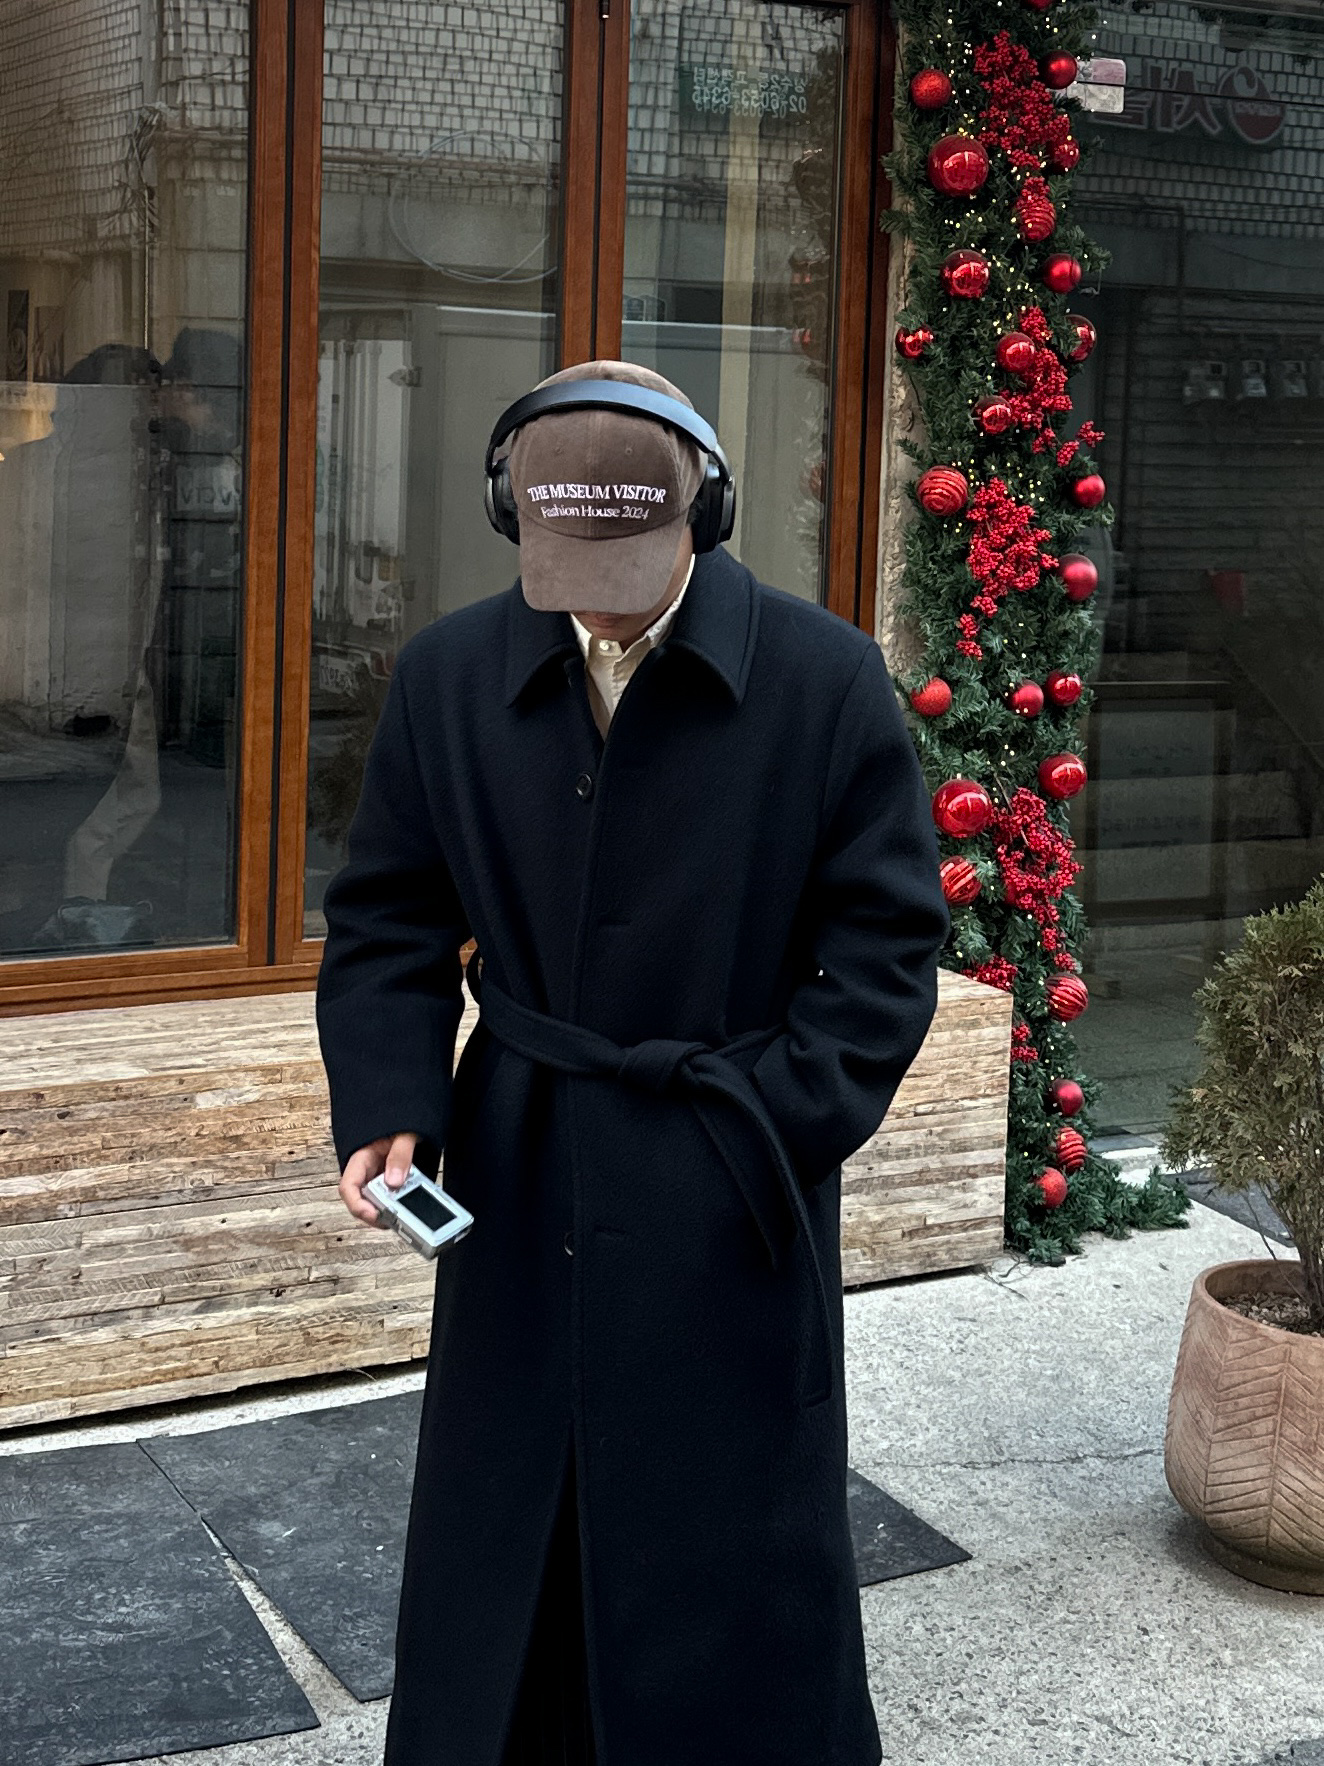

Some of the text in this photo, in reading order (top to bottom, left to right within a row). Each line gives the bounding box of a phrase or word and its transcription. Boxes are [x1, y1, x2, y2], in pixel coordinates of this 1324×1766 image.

[527, 483, 667, 503] THE MUSEUM VISITOR
[540, 504, 649, 520] Fashion House 2024
